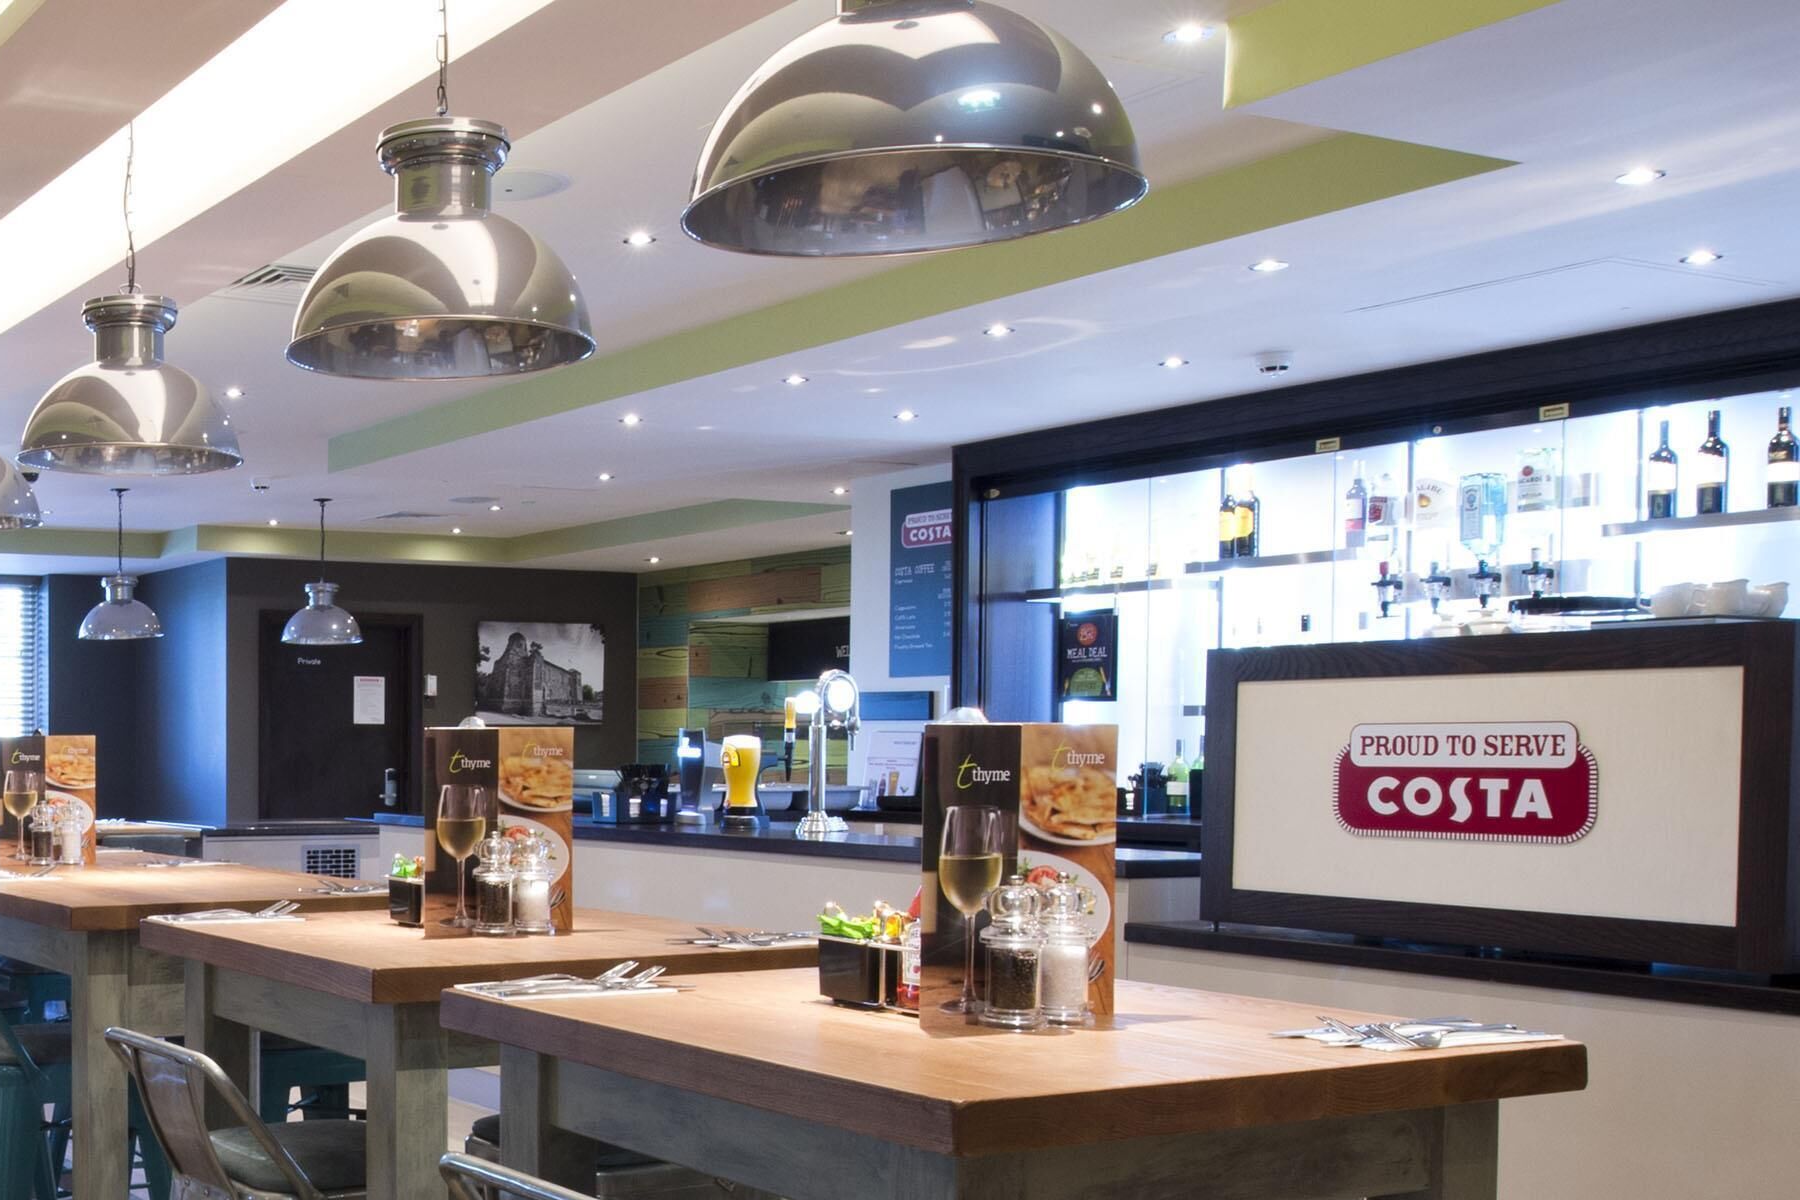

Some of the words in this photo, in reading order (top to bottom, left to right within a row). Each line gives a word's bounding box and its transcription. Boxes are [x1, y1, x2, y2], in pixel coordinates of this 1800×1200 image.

[909, 525, 952, 541] COSTA
[1066, 648, 1087, 659] MEAL
[1089, 646, 1108, 658] DEAL
[297, 657, 322, 665] Private
[533, 745, 564, 758] thyme
[1359, 735, 1440, 757] PROUD
[1446, 735, 1476, 757] TO
[1483, 734, 1567, 757] SERVE
[461, 758, 492, 771] thyme
[1066, 749, 1106, 767] thyme
[972, 766, 1011, 786] thyme
[1366, 775, 1554, 824] COSTA
